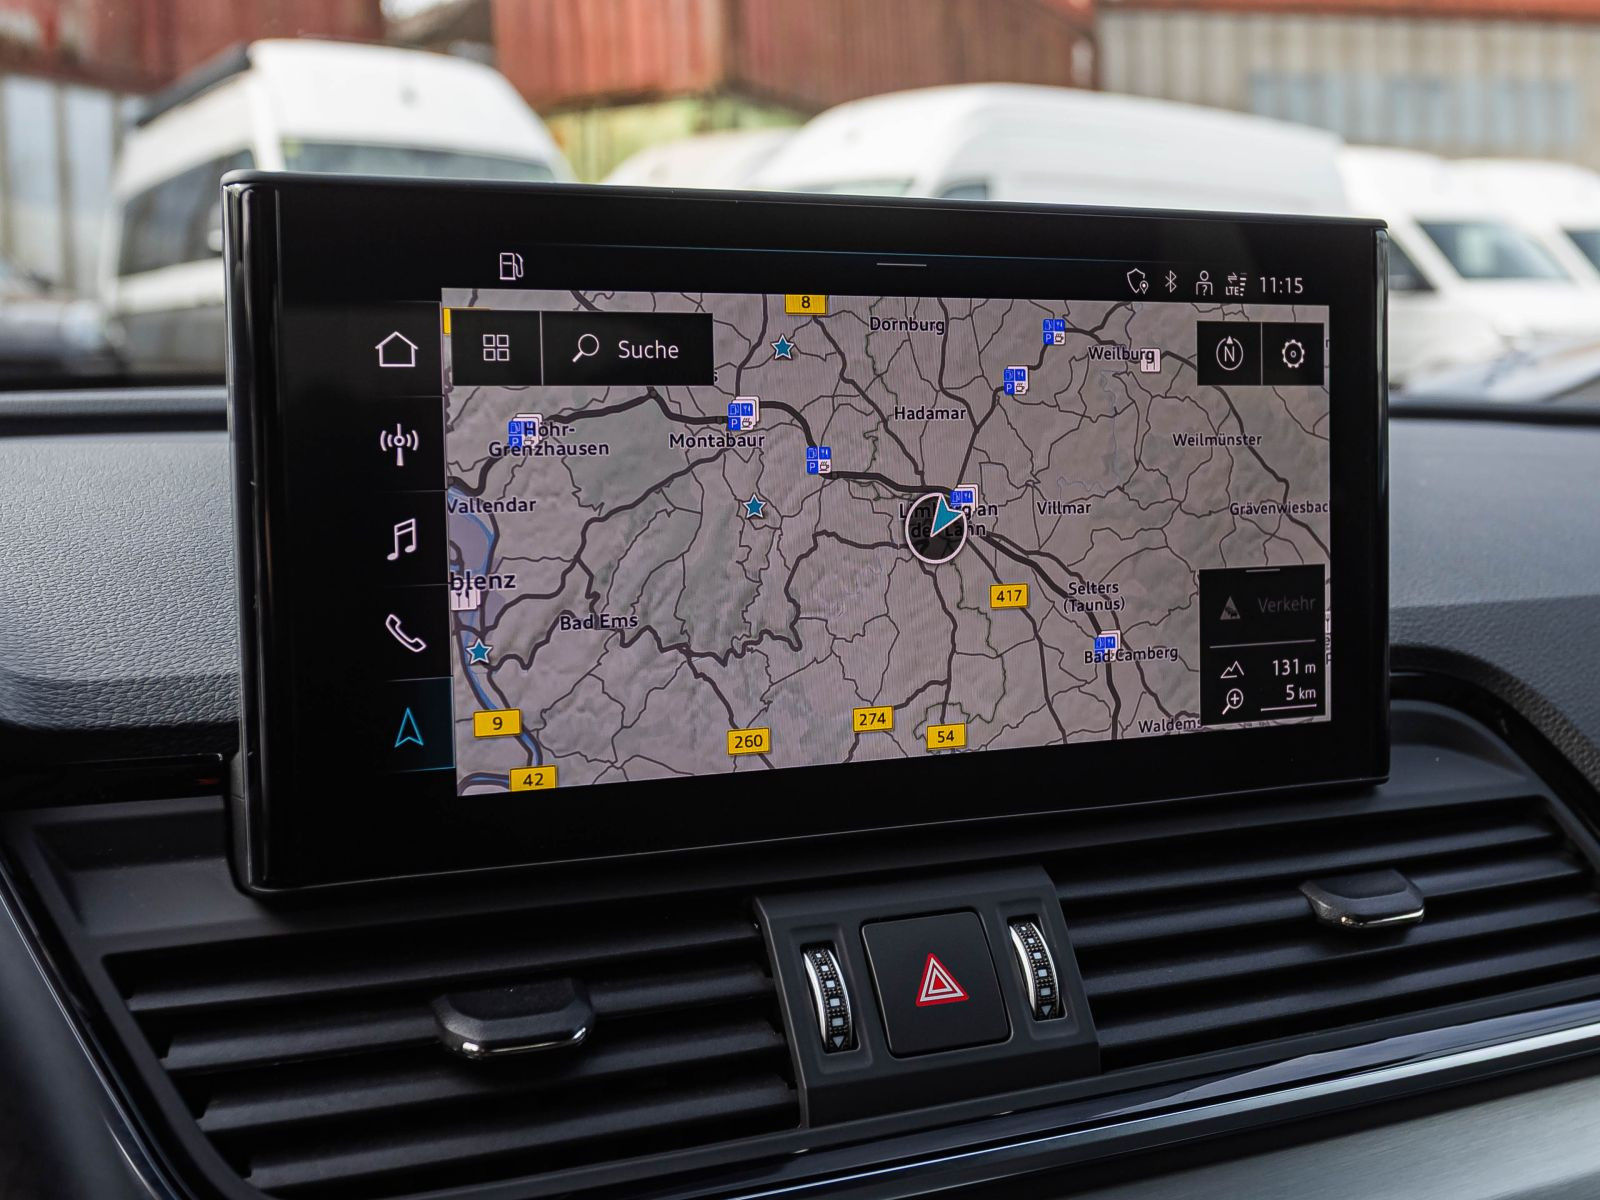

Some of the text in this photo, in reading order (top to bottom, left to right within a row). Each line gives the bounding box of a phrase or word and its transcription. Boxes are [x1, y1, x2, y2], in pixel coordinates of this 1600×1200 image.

[1225, 286, 1239, 296] LTE
[1260, 276, 1304, 295] 11:15
[801, 295, 811, 309] 8
[870, 316, 945, 335] Dornburg
[618, 340, 679, 360] Suche
[1088, 345, 1155, 363] Weilburg
[1224, 346, 1236, 363] N
[894, 406, 966, 420] Hadamar
[524, 422, 575, 437] Höhr-
[669, 433, 765, 449] Montabaur
[1173, 433, 1262, 447] Weilmünster
[488, 441, 610, 457] Grenzhausen
[447, 497, 536, 514] Vallendar
[977, 504, 998, 516] an
[1037, 501, 1091, 515] Villmar
[1230, 501, 1329, 516] Grävenwiesbac
[450, 571, 516, 591] blenz
[1068, 582, 1119, 595] Selters
[996, 589, 1022, 601] 417
[1063, 596, 1126, 614] (Taunus)
[1257, 597, 1316, 615] Verkehr
[560, 613, 639, 631] Bad Ems
[1084, 647, 1178, 664] Bad Camberg
[1272, 659, 1316, 677] 131 m
[1285, 684, 1316, 701] 5 km
[492, 716, 503, 731] 9
[859, 712, 886, 726] 274
[734, 734, 763, 749] 260
[937, 729, 955, 743] 54
[522, 772, 544, 786] 42
